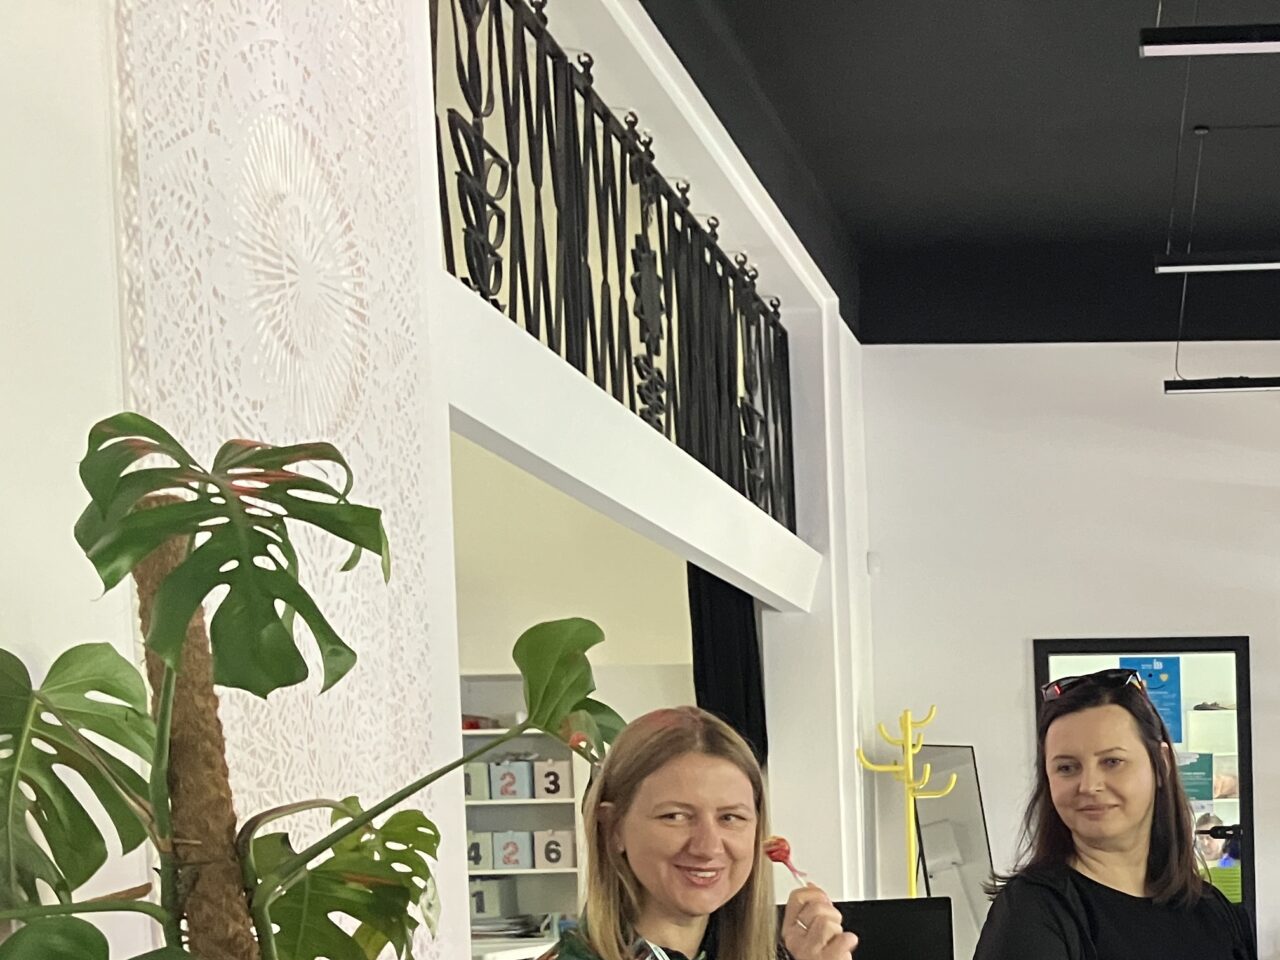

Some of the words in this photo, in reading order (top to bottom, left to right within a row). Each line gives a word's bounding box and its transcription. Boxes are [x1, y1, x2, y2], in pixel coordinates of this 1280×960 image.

[544, 771, 561, 795] 3
[468, 842, 482, 865] 4
[544, 840, 561, 863] 6
[472, 890, 485, 914] 1
